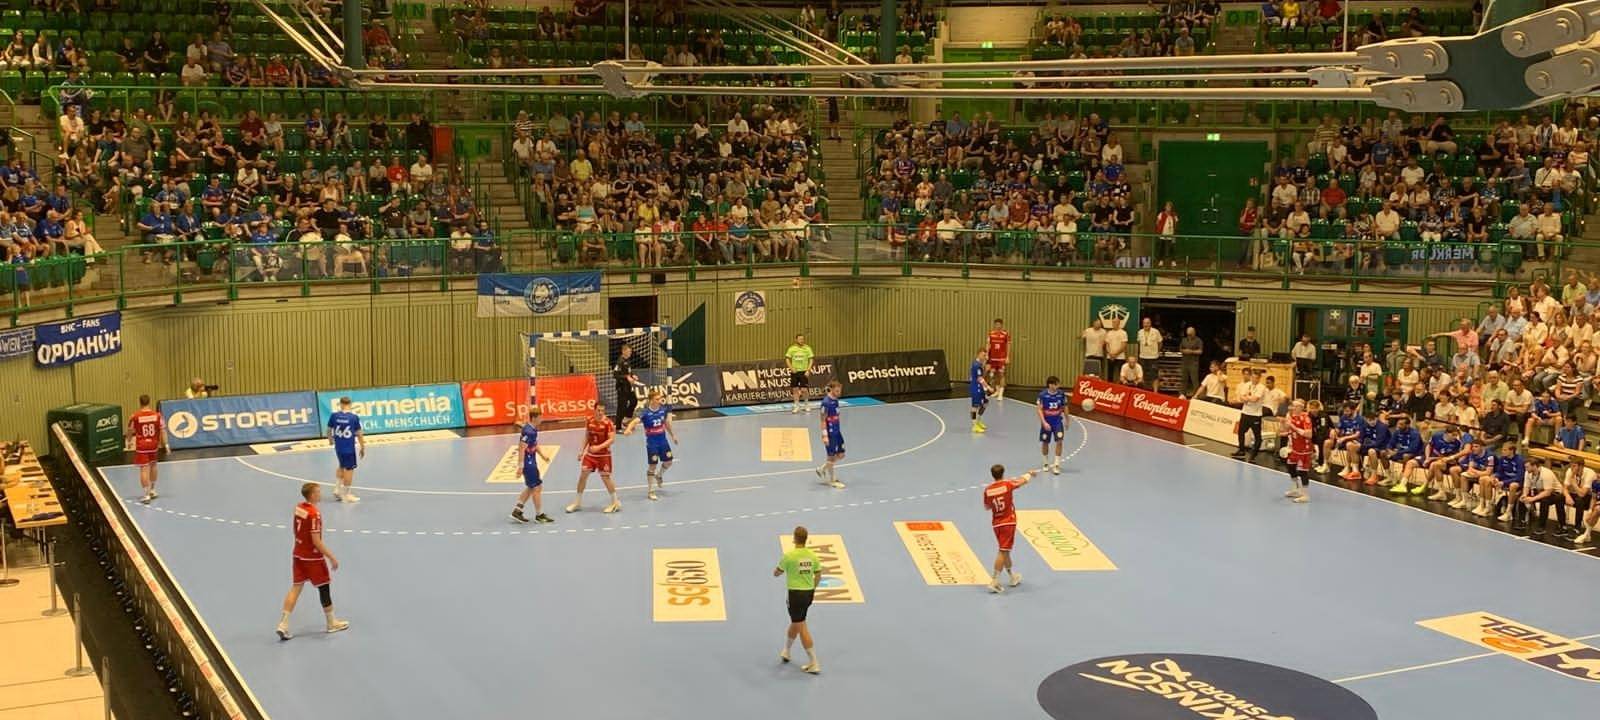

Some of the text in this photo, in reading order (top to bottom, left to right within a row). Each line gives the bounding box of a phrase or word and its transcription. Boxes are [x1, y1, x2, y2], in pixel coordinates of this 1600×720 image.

[37, 328, 120, 364] OPDAHÜH
[767, 377, 792, 388] NUSS
[848, 365, 936, 383] pechschwarz
[1080, 380, 1126, 403] Coroplast
[505, 399, 595, 421] Sprkasse
[1133, 393, 1183, 418] Coroplast
[142, 423, 155, 437] 68
[335, 425, 352, 439] 46
[992, 496, 1006, 512] 15
[657, 560, 720, 606] SG/650
[1480, 615, 1570, 649] HBL
[1095, 659, 1256, 720] KINSON
[1186, 679, 1270, 716] SWORD
